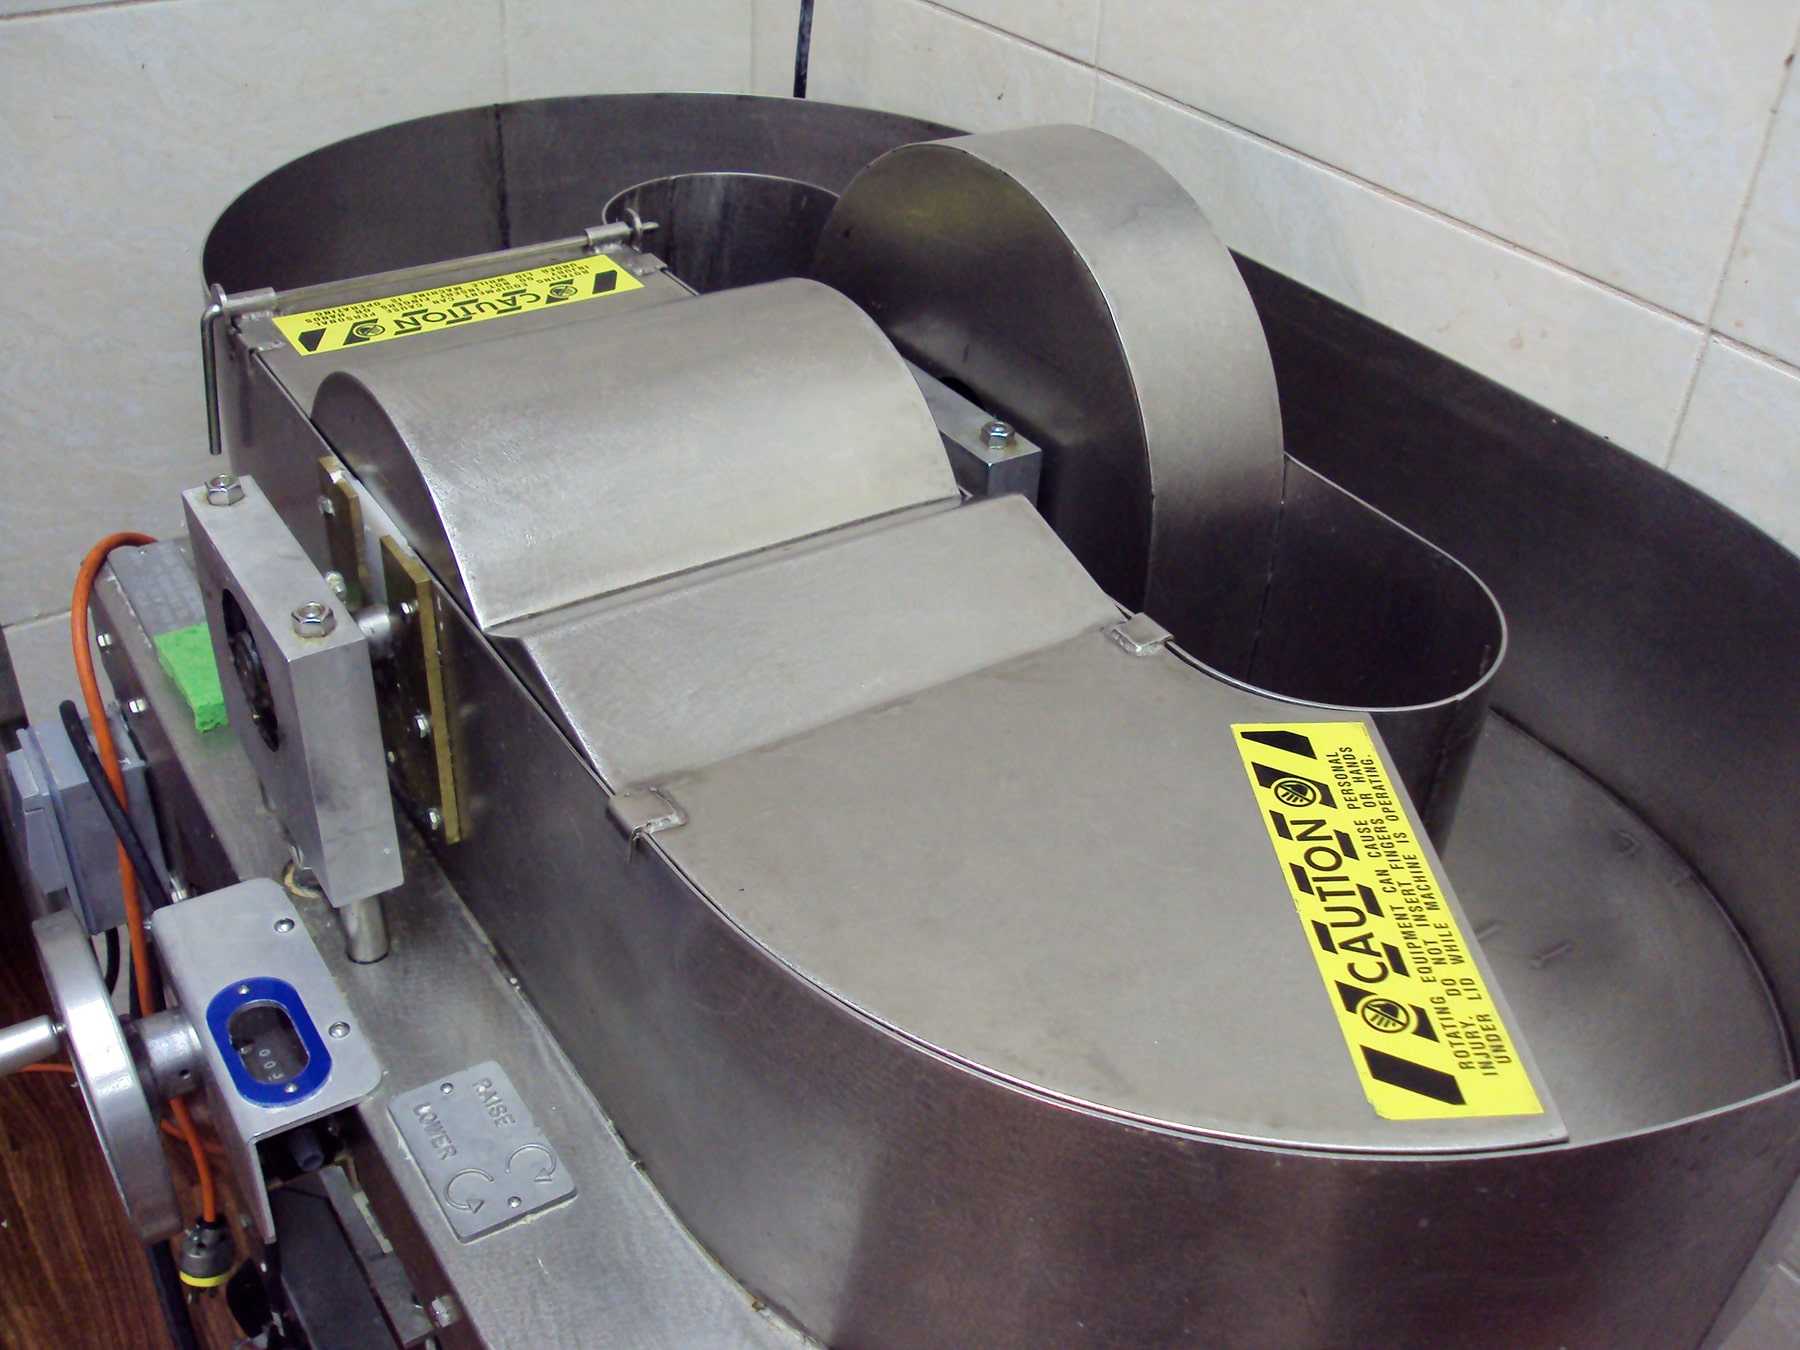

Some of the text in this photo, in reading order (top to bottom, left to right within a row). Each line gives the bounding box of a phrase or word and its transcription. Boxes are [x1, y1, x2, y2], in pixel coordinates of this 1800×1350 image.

[515, 271, 533, 279] LID
[541, 263, 577, 274] UNDER
[413, 286, 462, 299] MACHINE
[440, 287, 480, 299] INSERT
[473, 277, 507, 287] WHILE
[493, 281, 511, 289] NOT
[316, 271, 589, 326] ROTATING EQUIPMENT CAN CAUSE PERSONAL
[380, 296, 430, 309] FINGERS
[305, 311, 345, 324] HANDS
[393, 293, 541, 329] CAUTION
[1290, 818, 1389, 984] CAUTION
[1326, 752, 1476, 1070] ROTATING EQUIPMENT CAN CAUSE PERSONAL
[1339, 746, 1499, 1076] INJURY. DO NOT INSERT FINGERS OR HANDS
[1361, 754, 1512, 1064] UNDER LID WHILE MACHINE IS OPERATING.
[472, 1077, 516, 1127] RAISE
[412, 1101, 458, 1160] LOWER
